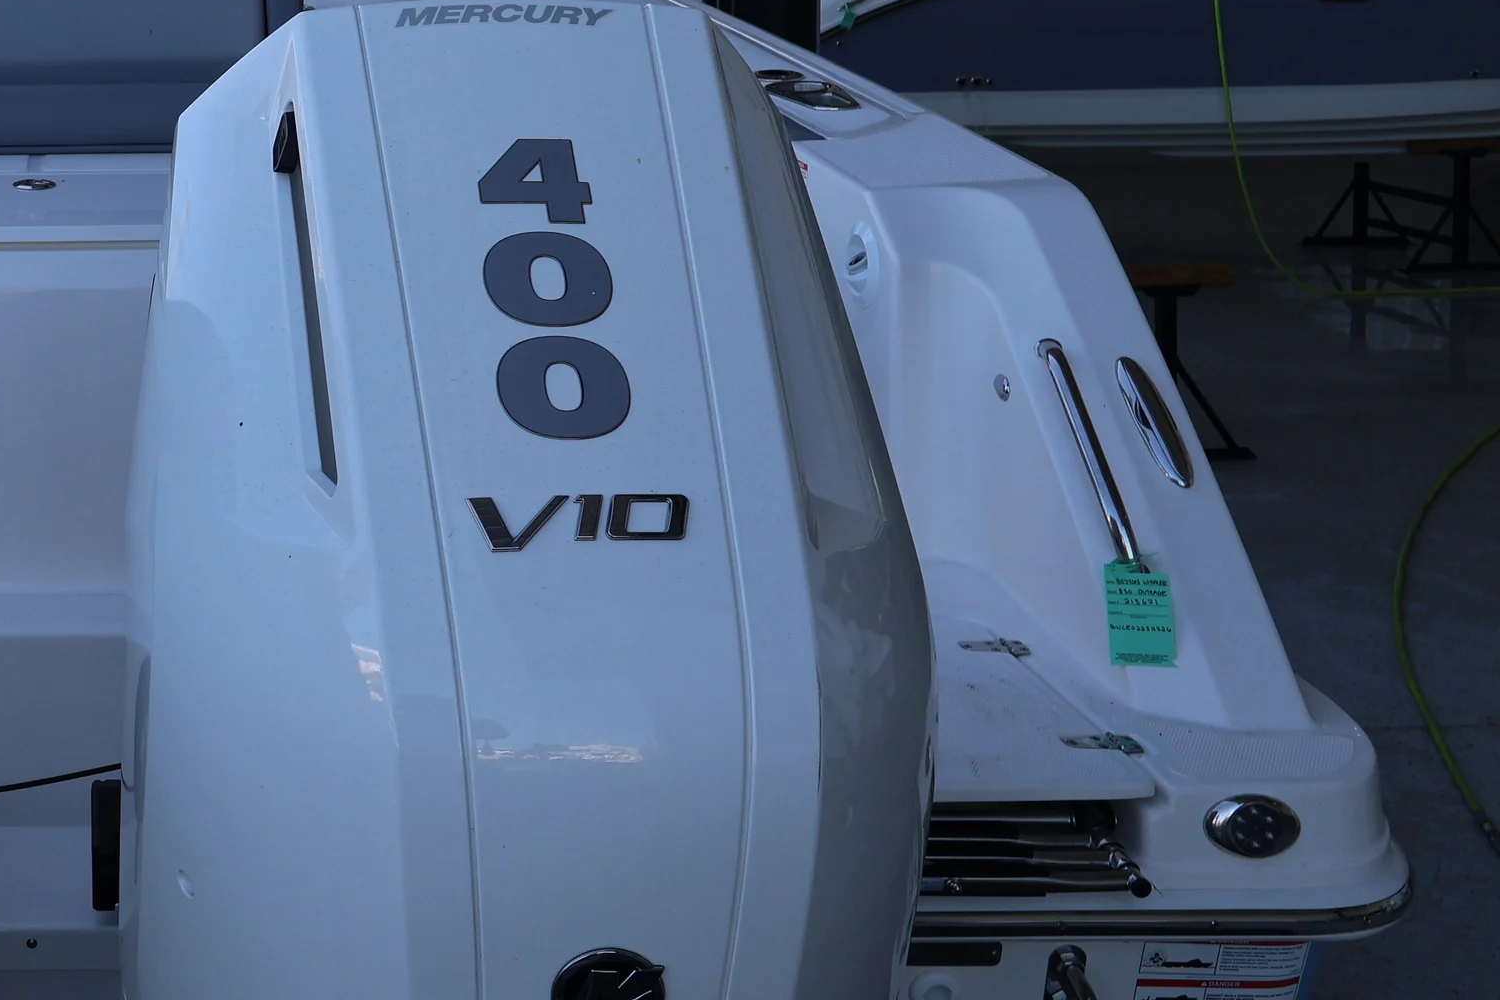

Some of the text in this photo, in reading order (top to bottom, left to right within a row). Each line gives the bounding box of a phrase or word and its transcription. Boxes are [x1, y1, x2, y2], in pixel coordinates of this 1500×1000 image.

[395, 3, 613, 28] MERCURY
[478, 138, 632, 441] 400
[465, 494, 690, 553] V10
